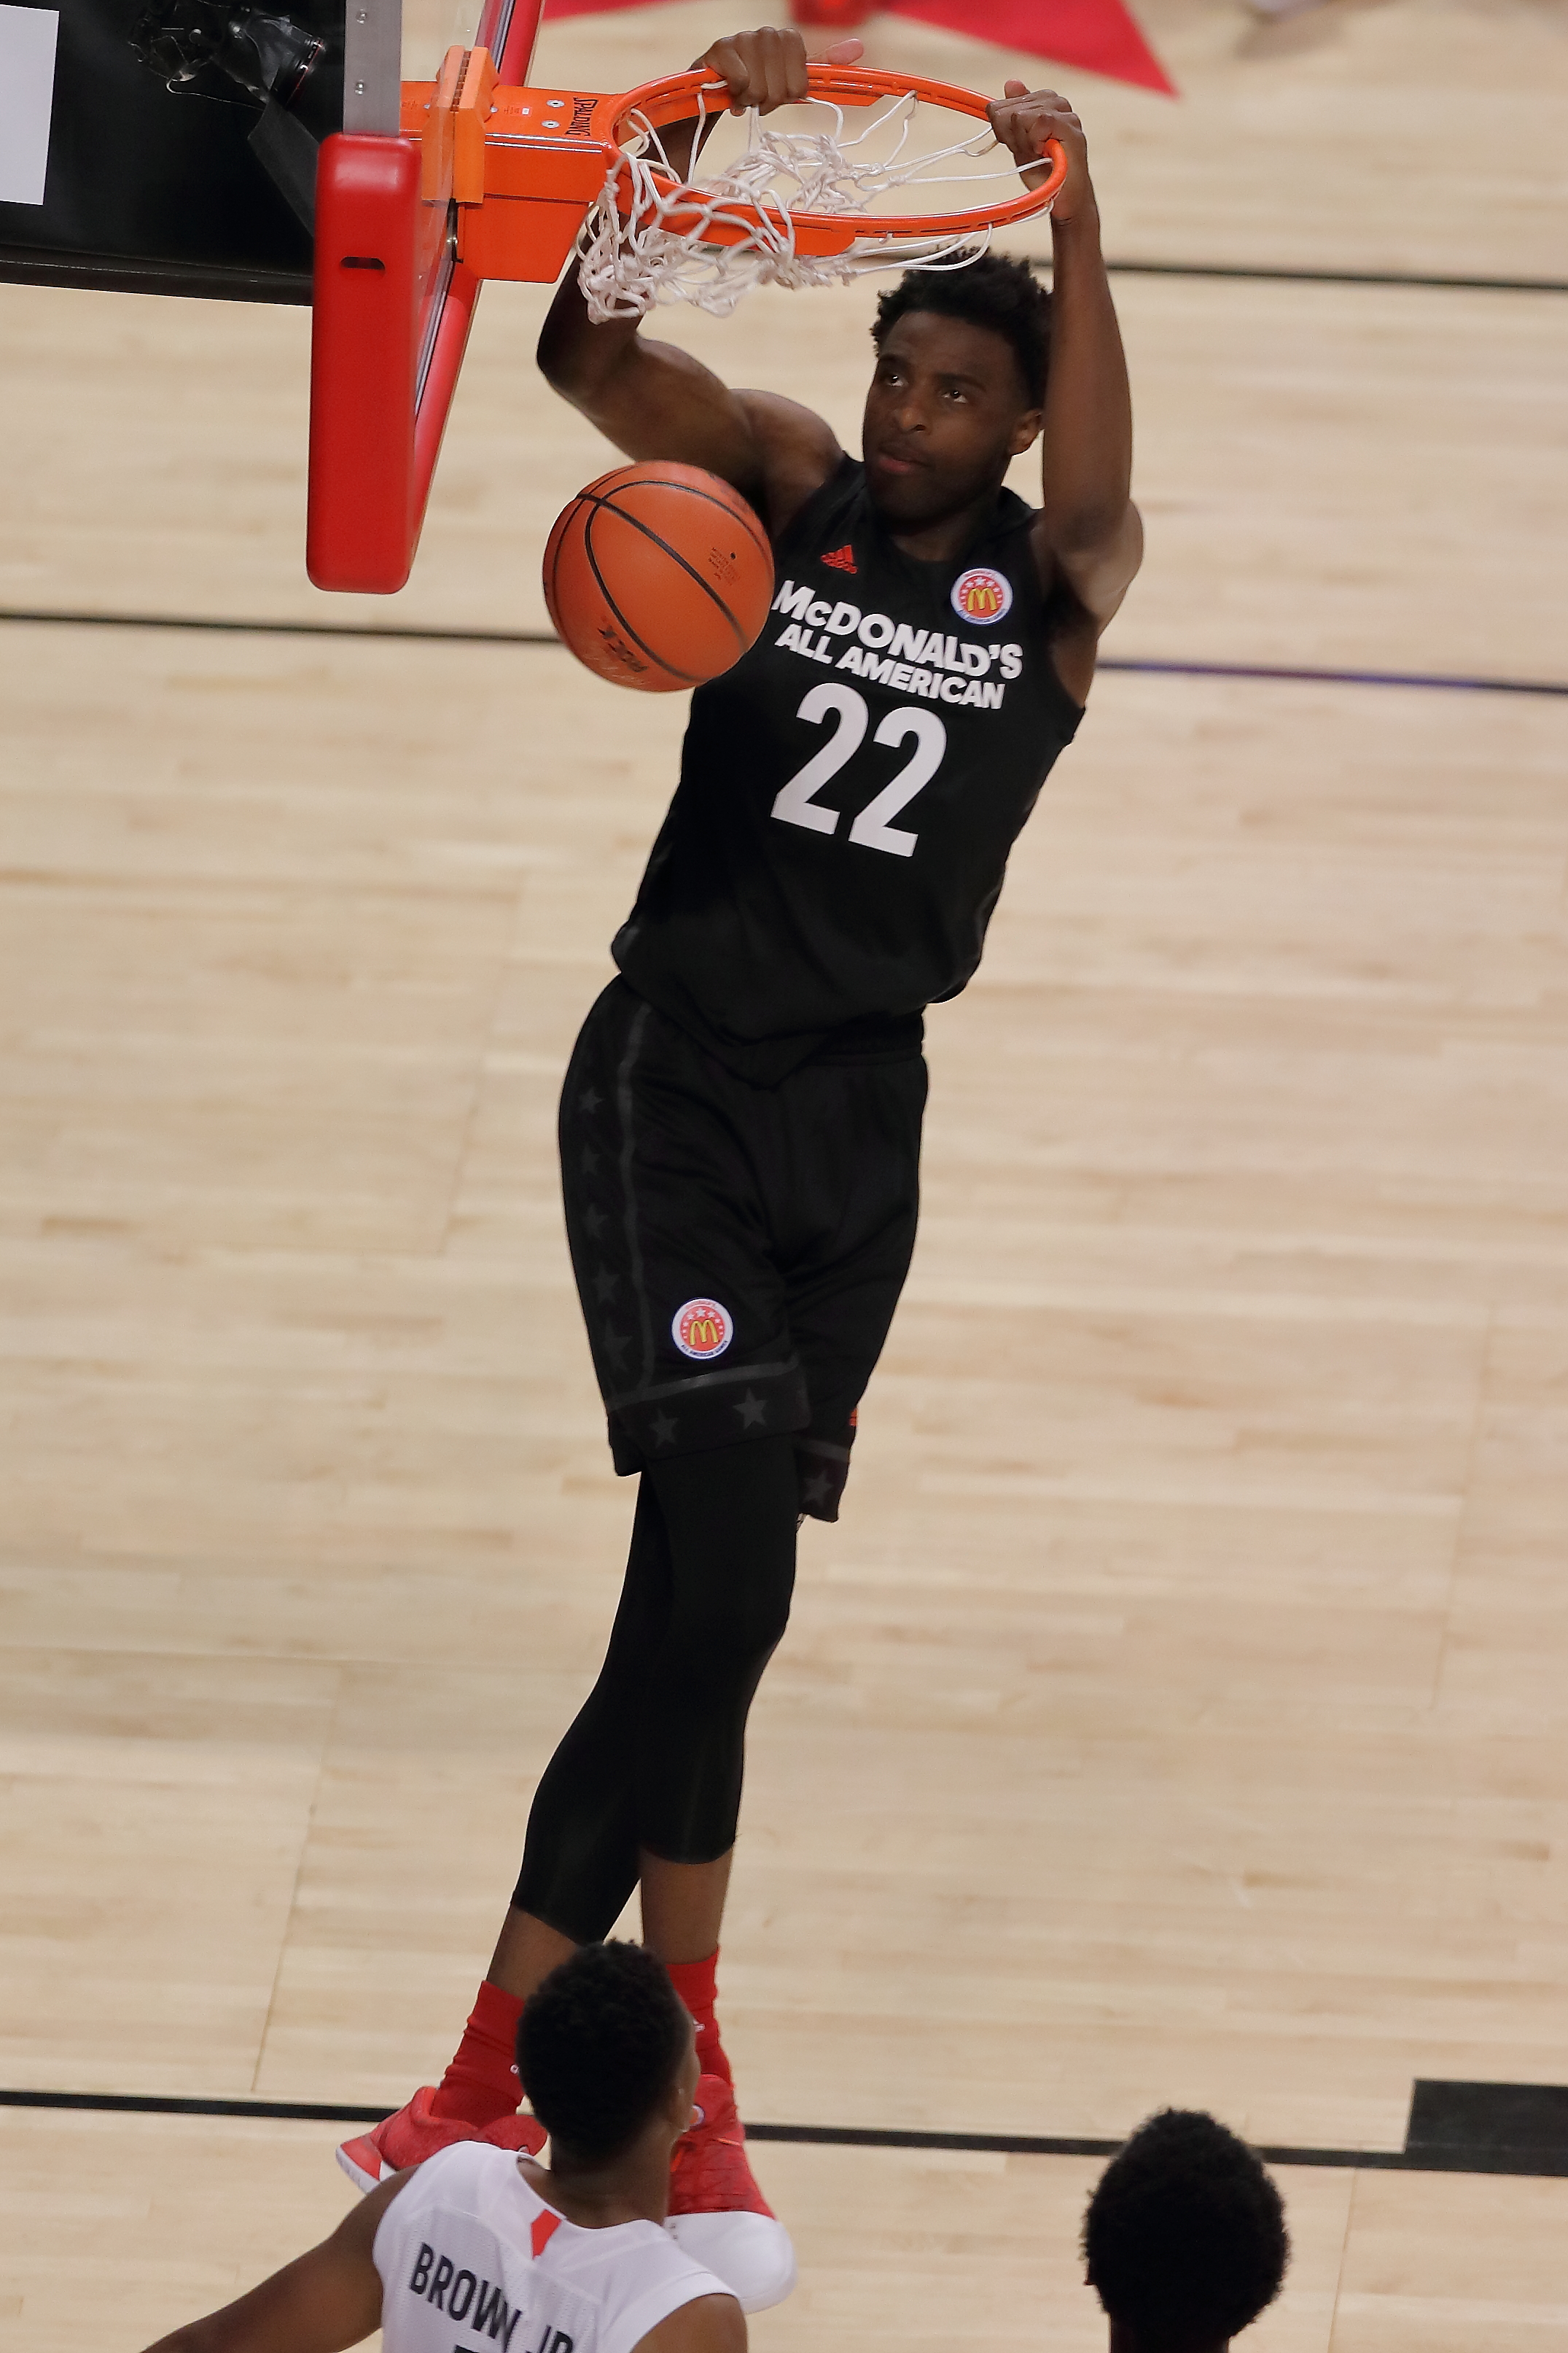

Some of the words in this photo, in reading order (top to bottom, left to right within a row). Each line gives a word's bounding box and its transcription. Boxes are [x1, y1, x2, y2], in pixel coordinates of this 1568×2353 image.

[564, 96, 598, 137] SPALDING
[771, 580, 1023, 680] McDONALD'S
[774, 623, 834, 664] ALL
[835, 646, 1006, 709] AMERICAN
[770, 682, 948, 858] 22
[409, 2242, 522, 2353] BROWN
